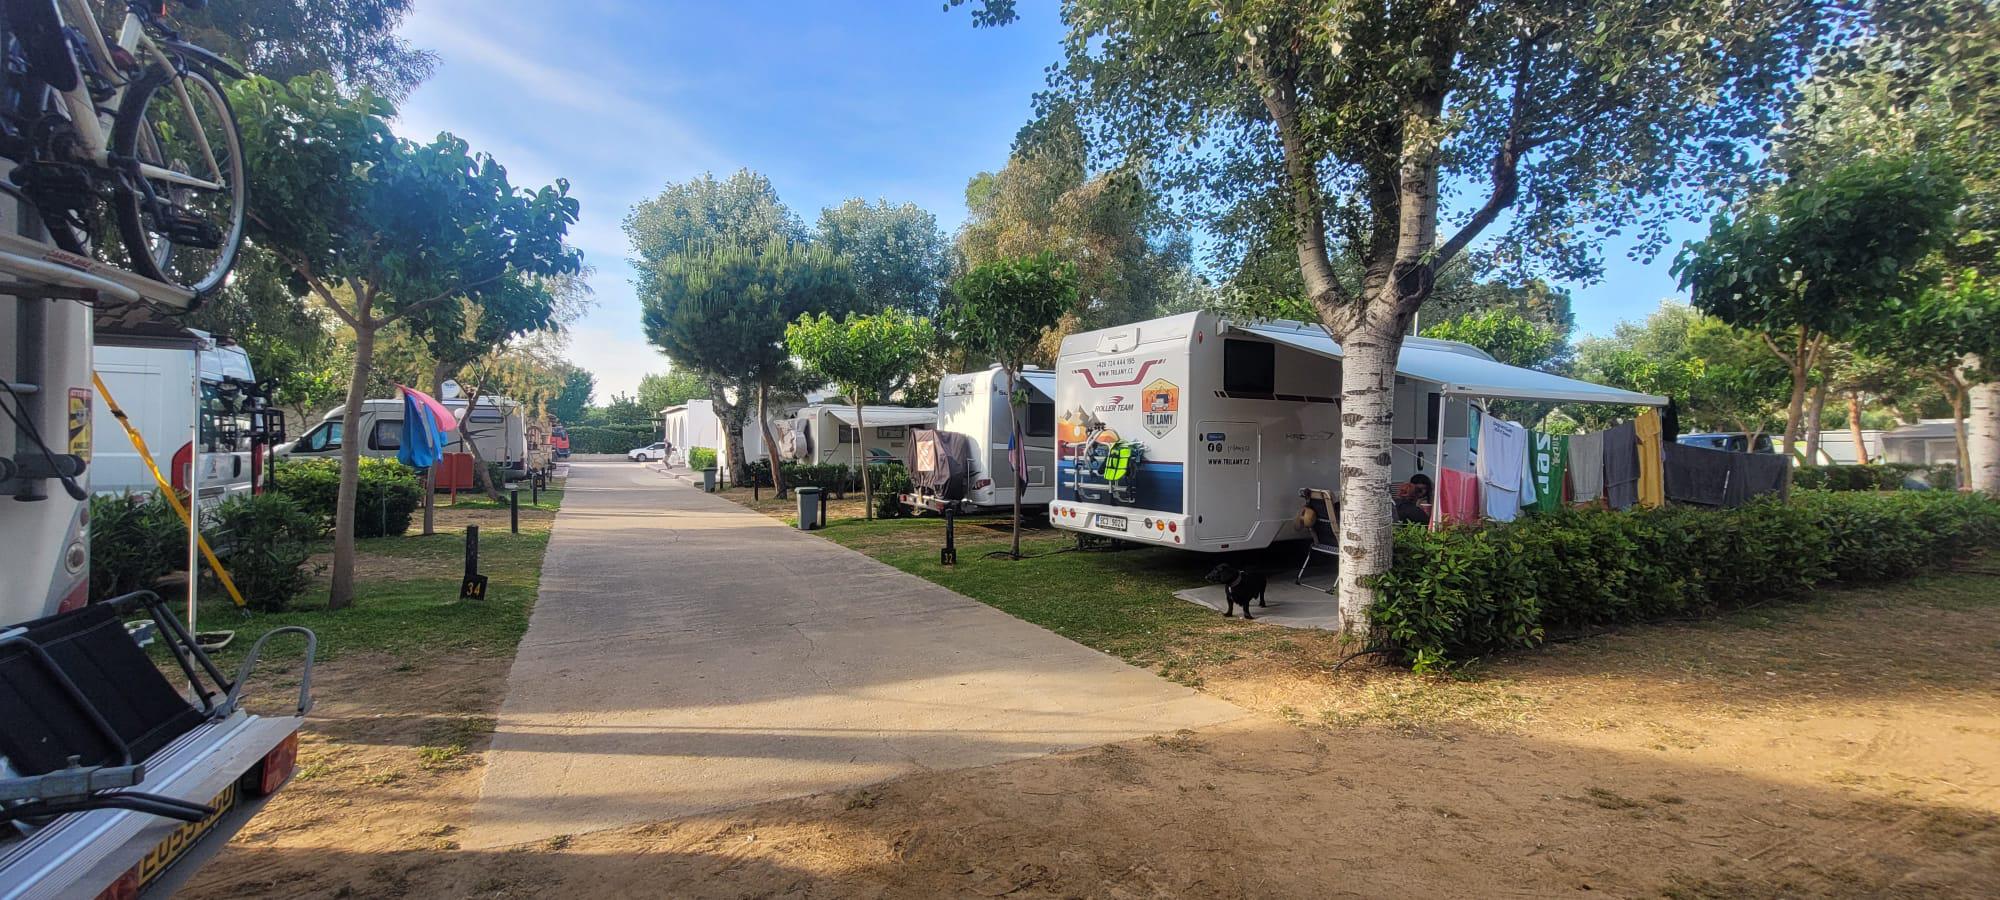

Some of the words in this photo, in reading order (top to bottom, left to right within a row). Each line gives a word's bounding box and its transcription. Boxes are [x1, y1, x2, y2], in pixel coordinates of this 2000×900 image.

[1095, 404, 1116, 413] ROLLER
[1146, 412, 1155, 425] TŘI
[1156, 414, 1173, 425] LAMY
[944, 552, 953, 564] 32
[466, 581, 481, 596] 34
